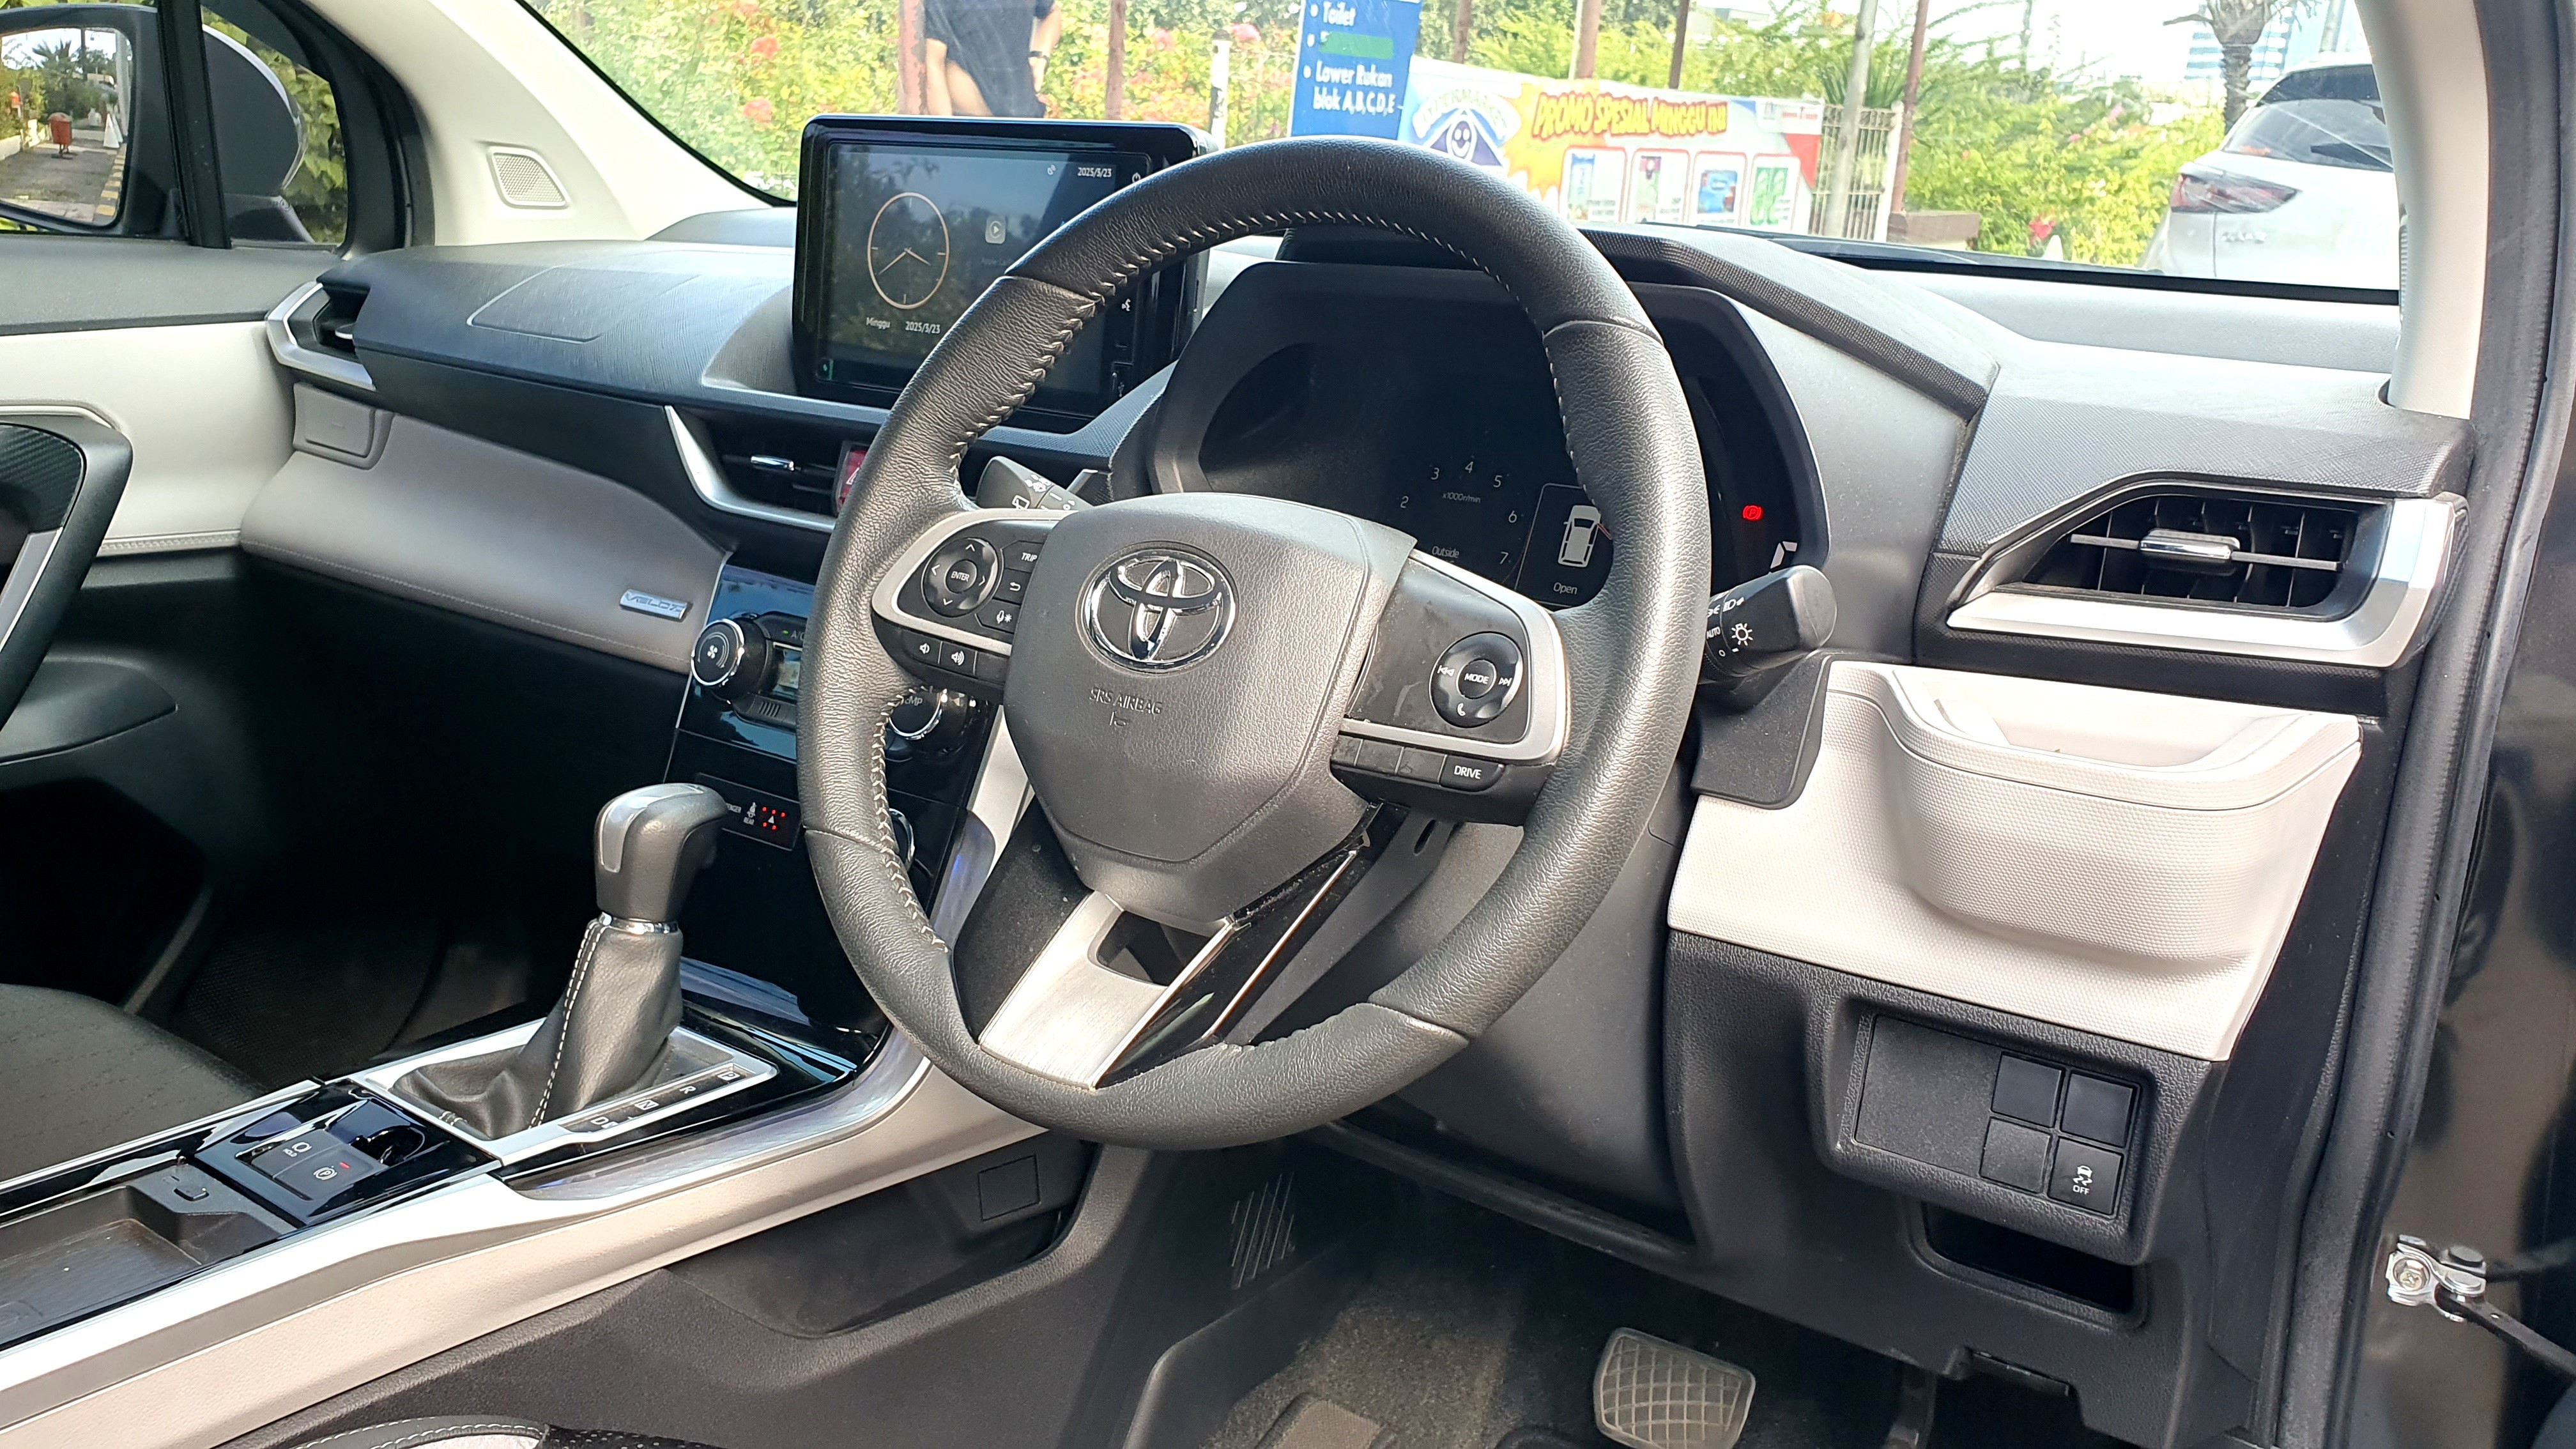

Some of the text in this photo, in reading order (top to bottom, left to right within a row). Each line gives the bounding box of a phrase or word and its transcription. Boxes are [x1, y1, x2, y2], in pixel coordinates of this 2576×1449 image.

[1323, 1, 1356, 26] Toilet
[1315, 59, 1393, 88] Lower Rukan
[1313, 86, 1341, 111] blok
[1532, 91, 1594, 141] PROMO
[1593, 93, 1650, 135] SPESIAL
[1650, 97, 1706, 137] MINGGU
[866, 317, 891, 330] Minggu
[1430, 467, 1440, 480] 3
[1464, 461, 1474, 473] 4
[1492, 475, 1503, 488] 5
[1400, 495, 1409, 509] 2
[1508, 510, 1518, 523] 6
[1021, 552, 1038, 562] TRIP
[1432, 546, 1460, 558] Outside
[1499, 551, 1509, 564] 7
[951, 571, 970, 583] ENTER
[1553, 581, 1578, 595] Open
[1706, 626, 1721, 640] AUTO
[1464, 673, 1490, 684] MODE
[1089, 687, 1163, 715] SRS AIRBAG
[1453, 765, 1482, 779] DRIVE
[679, 1085, 696, 1094] R
[590, 1116, 609, 1126] D
[2073, 1184, 2090, 1195] OFF
